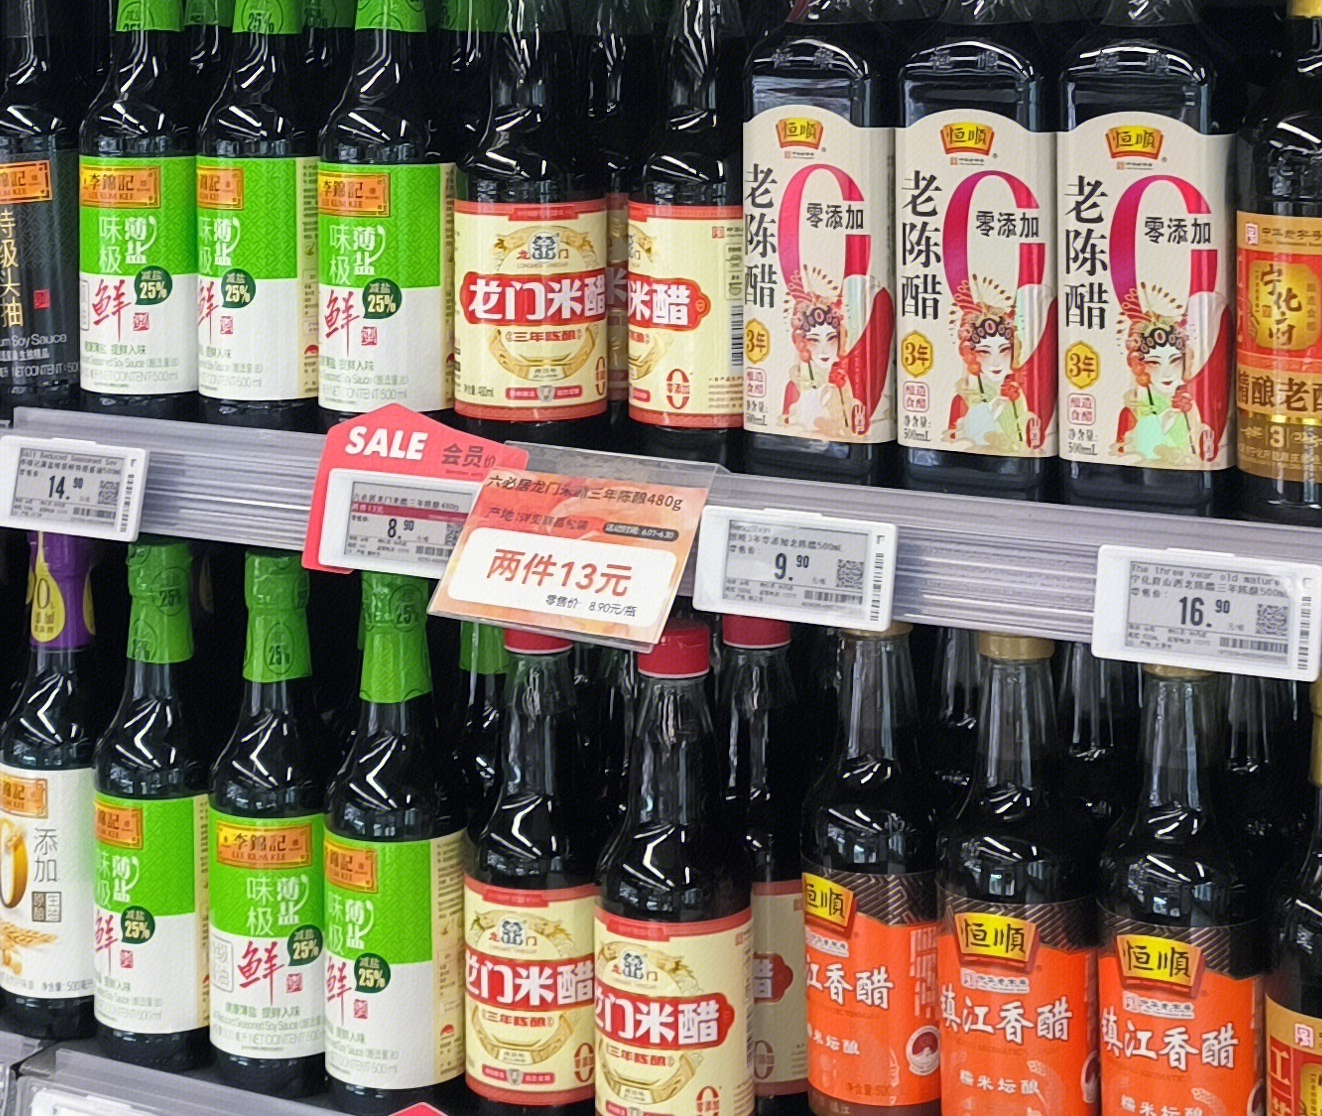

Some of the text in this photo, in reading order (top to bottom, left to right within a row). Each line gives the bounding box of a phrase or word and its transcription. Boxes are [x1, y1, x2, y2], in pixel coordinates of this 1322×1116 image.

[806, 201, 865, 231] 零添加
[976, 209, 1040, 239] 零添加
[1144, 216, 1212, 245] 零添加
[124, 216, 157, 265] 薄盐
[353, 224, 385, 277] 薄盐
[744, 163, 779, 310] 老陈醋
[901, 169, 943, 320] 老陈醋
[1064, 174, 1110, 330] 老陈醋
[139, 281, 168, 299] 25%
[225, 284, 251, 303] 25%
[368, 295, 397, 314] 25%
[32, 333, 67, 346] Sauce
[745, 331, 767, 353] 3年
[904, 343, 930, 365] 3年
[1068, 353, 1096, 376] 3年
[345, 426, 429, 461] SALE
[441, 443, 496, 467] 会员价
[388, 518, 415, 540] 8.90
[486, 548, 633, 597] 两件13元
[774, 552, 810, 581] 9.90
[1179, 595, 1231, 628] 16.90
[33, 827, 60, 883] 添加
[124, 918, 150, 939] 25%
[292, 937, 320, 958] 25%
[358, 965, 386, 986] 25%
[940, 984, 1074, 1044] 镇江香醋
[1101, 1006, 1239, 1071] 镇江香醋
